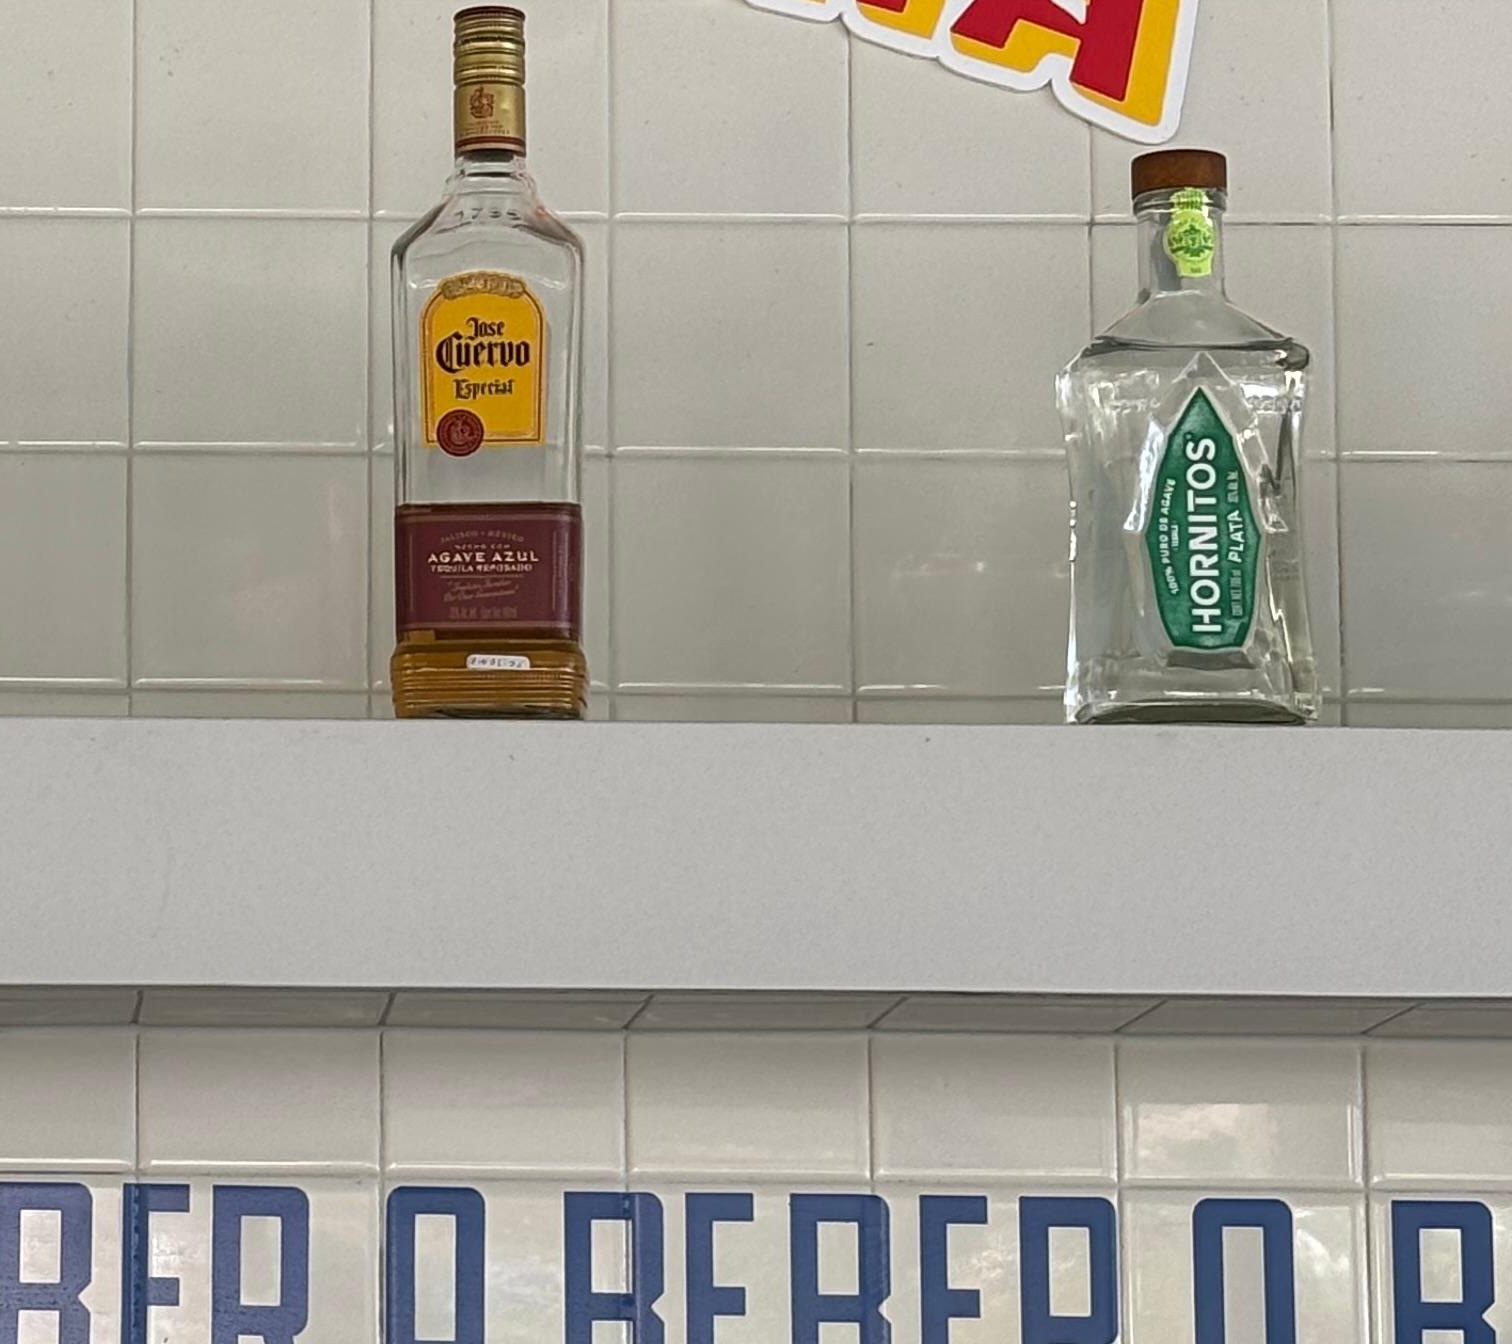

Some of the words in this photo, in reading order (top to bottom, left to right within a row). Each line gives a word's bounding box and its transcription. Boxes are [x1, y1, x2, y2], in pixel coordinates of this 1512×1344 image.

[466, 317, 505, 340] Jose
[435, 331, 530, 374] Cuervo
[453, 378, 515, 400] Especial
[1160, 478, 1176, 515] AGAVE
[1159, 535, 1171, 564] PURO
[1185, 437, 1222, 633] HORNITOS
[1227, 509, 1246, 563] PLATA
[427, 552, 486, 564] AGAVE
[492, 550, 540, 563] AZUL
